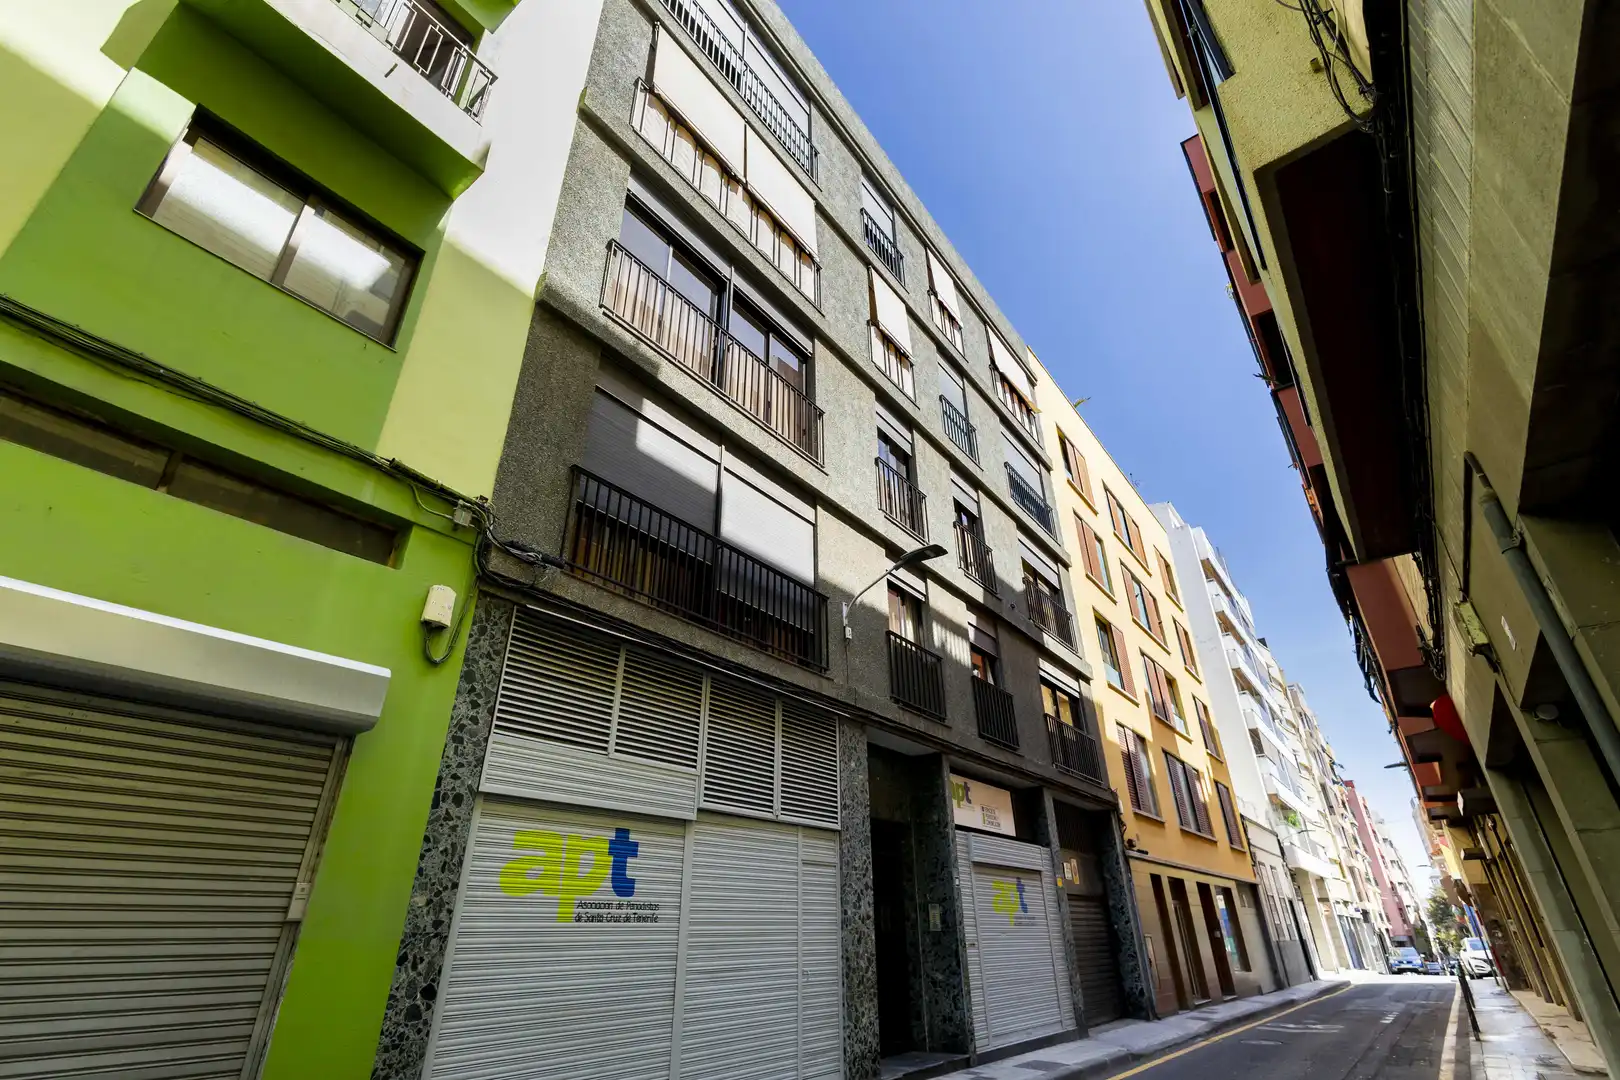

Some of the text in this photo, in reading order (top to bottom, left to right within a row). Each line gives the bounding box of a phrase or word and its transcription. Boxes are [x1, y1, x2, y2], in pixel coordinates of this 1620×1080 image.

[499, 827, 639, 923] apt
[616, 901, 625, 910] de
[992, 876, 1028, 927] apt
[574, 912, 659, 923] de Santa Cruz de Tenerife
